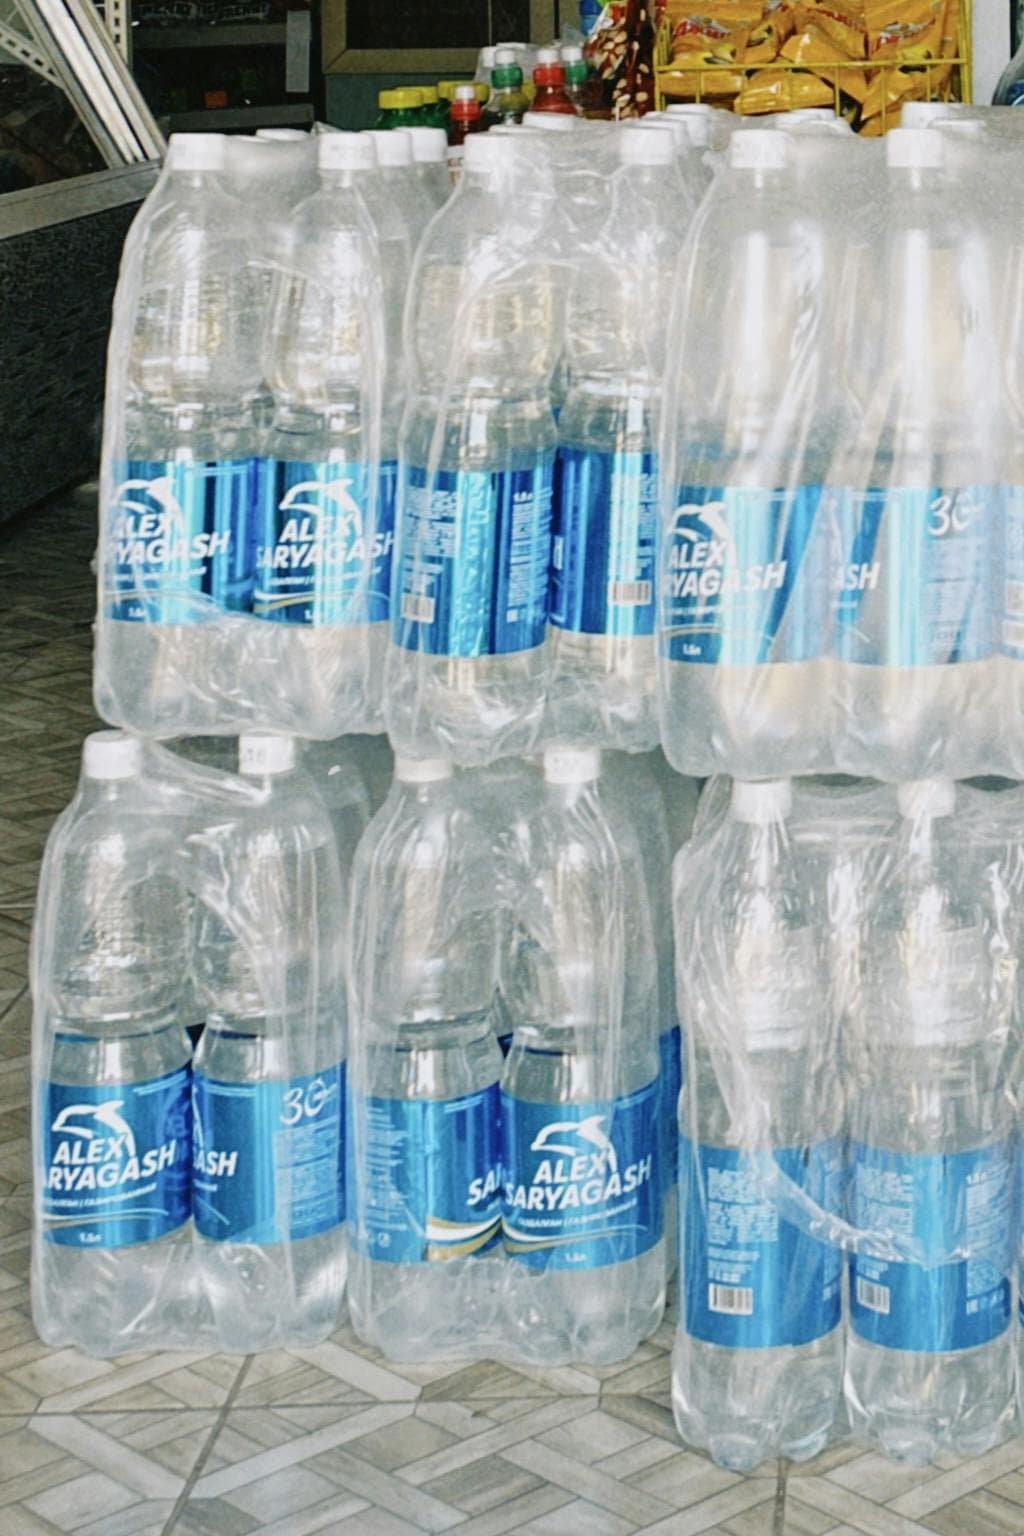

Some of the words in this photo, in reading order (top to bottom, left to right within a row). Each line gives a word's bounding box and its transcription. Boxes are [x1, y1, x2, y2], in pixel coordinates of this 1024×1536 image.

[53, 1135, 126, 1165] ALEX
[504, 1154, 652, 1211] SARYAGASH
[532, 1152, 607, 1185] ALEX
